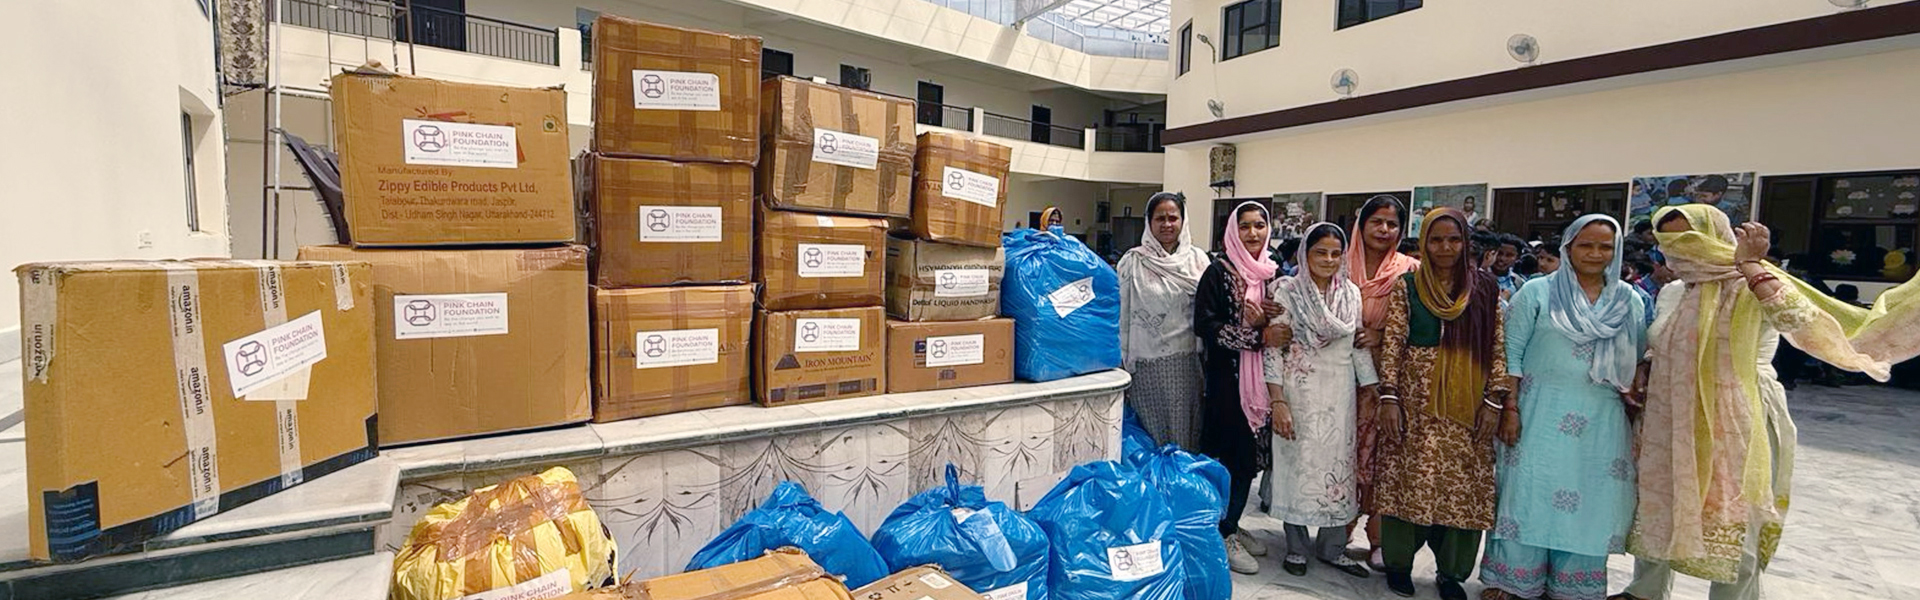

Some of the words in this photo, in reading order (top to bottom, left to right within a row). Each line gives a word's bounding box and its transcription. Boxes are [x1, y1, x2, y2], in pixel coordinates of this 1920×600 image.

[453, 138, 509, 147] FOUNDATION
[378, 167, 438, 175] Manufactured
[441, 168, 453, 177] By
[378, 180, 410, 193] Zippy
[414, 180, 448, 192] Edible
[451, 181, 498, 193] Products
[500, 182, 517, 192] Pvt
[520, 182, 538, 194] Ltd,
[405, 210, 433, 219] Udham
[435, 210, 457, 221] Singh
[268, 266, 279, 309] amazon.in
[182, 285, 193, 334] amazon.in
[272, 333, 291, 346] PINK
[292, 323, 313, 338] CHAIN
[273, 330, 318, 354] FOUNDATION
[191, 367, 203, 415] amazon.in
[202, 447, 211, 493] amazon.in
[526, 581, 557, 597] CHAIN
